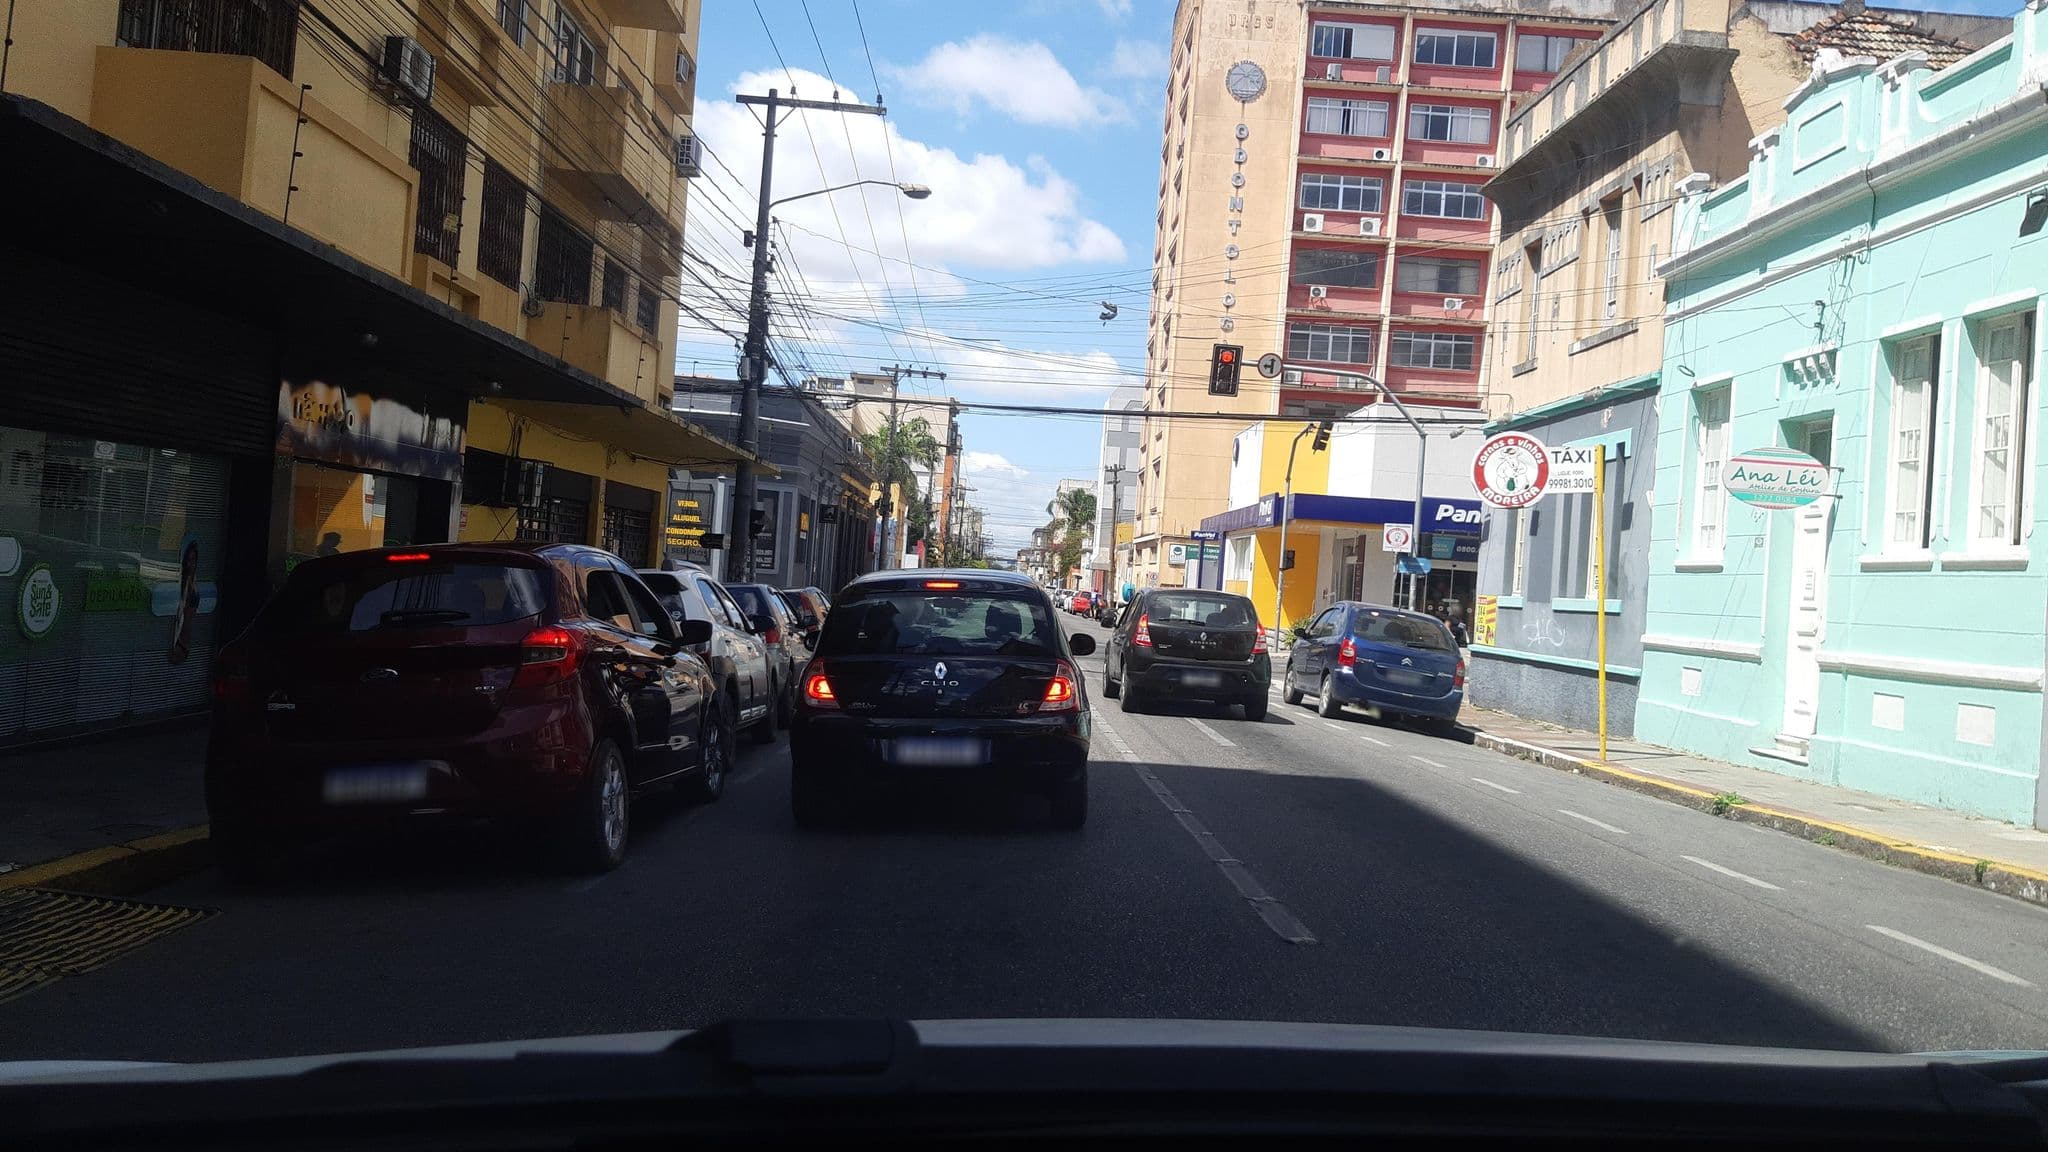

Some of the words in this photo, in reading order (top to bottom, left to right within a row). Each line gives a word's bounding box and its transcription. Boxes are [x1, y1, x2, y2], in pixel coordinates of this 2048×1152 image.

[1550, 446, 1592, 464] TÁXI
[1548, 477, 1594, 489] 99981.3010
[1730, 465, 1780, 483] Ana
[1786, 469, 1822, 486] Léi
[1481, 486, 1541, 506] MOREIRA
[1749, 483, 1775, 491] Atelier
[1778, 483, 1787, 492] de
[1789, 485, 1821, 495] Costura
[920, 679, 960, 687] CLIO
